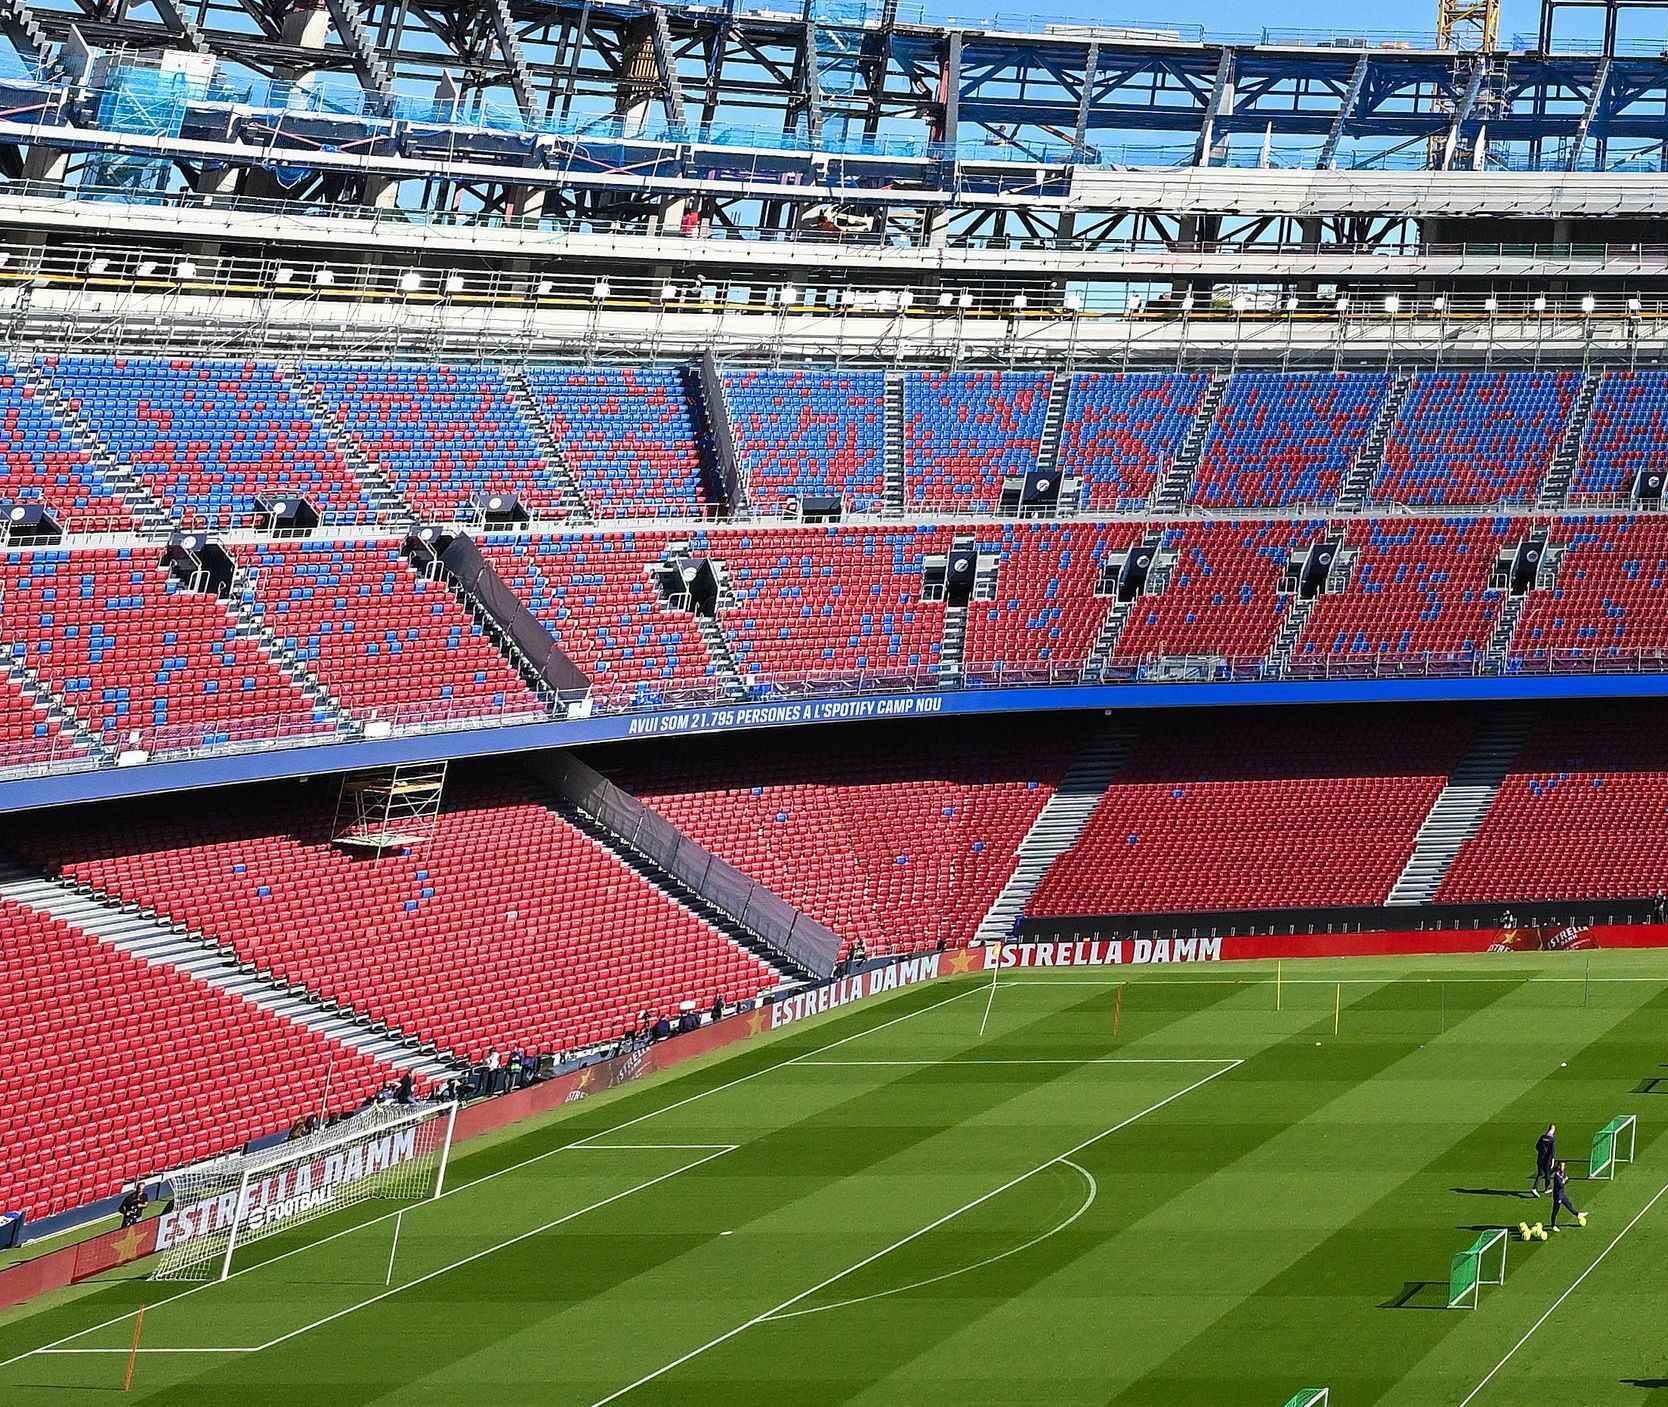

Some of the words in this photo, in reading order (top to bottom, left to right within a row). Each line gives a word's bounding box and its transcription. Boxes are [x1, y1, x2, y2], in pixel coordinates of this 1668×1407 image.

[628, 716, 658, 734] AVUI
[660, 714, 689, 732] SOM
[691, 711, 734, 729] 21.795
[736, 706, 803, 725] PERSONES
[803, 705, 812, 720] A
[814, 700, 874, 718] L'SPOTIFY
[877, 698, 914, 714] CAMP
[915, 697, 942, 712] NOU
[983, 939, 1122, 969] ESTRELLA
[1132, 936, 1223, 963] DAMM
[771, 974, 863, 1029] ESTRELLA
[869, 953, 940, 992] DAMM
